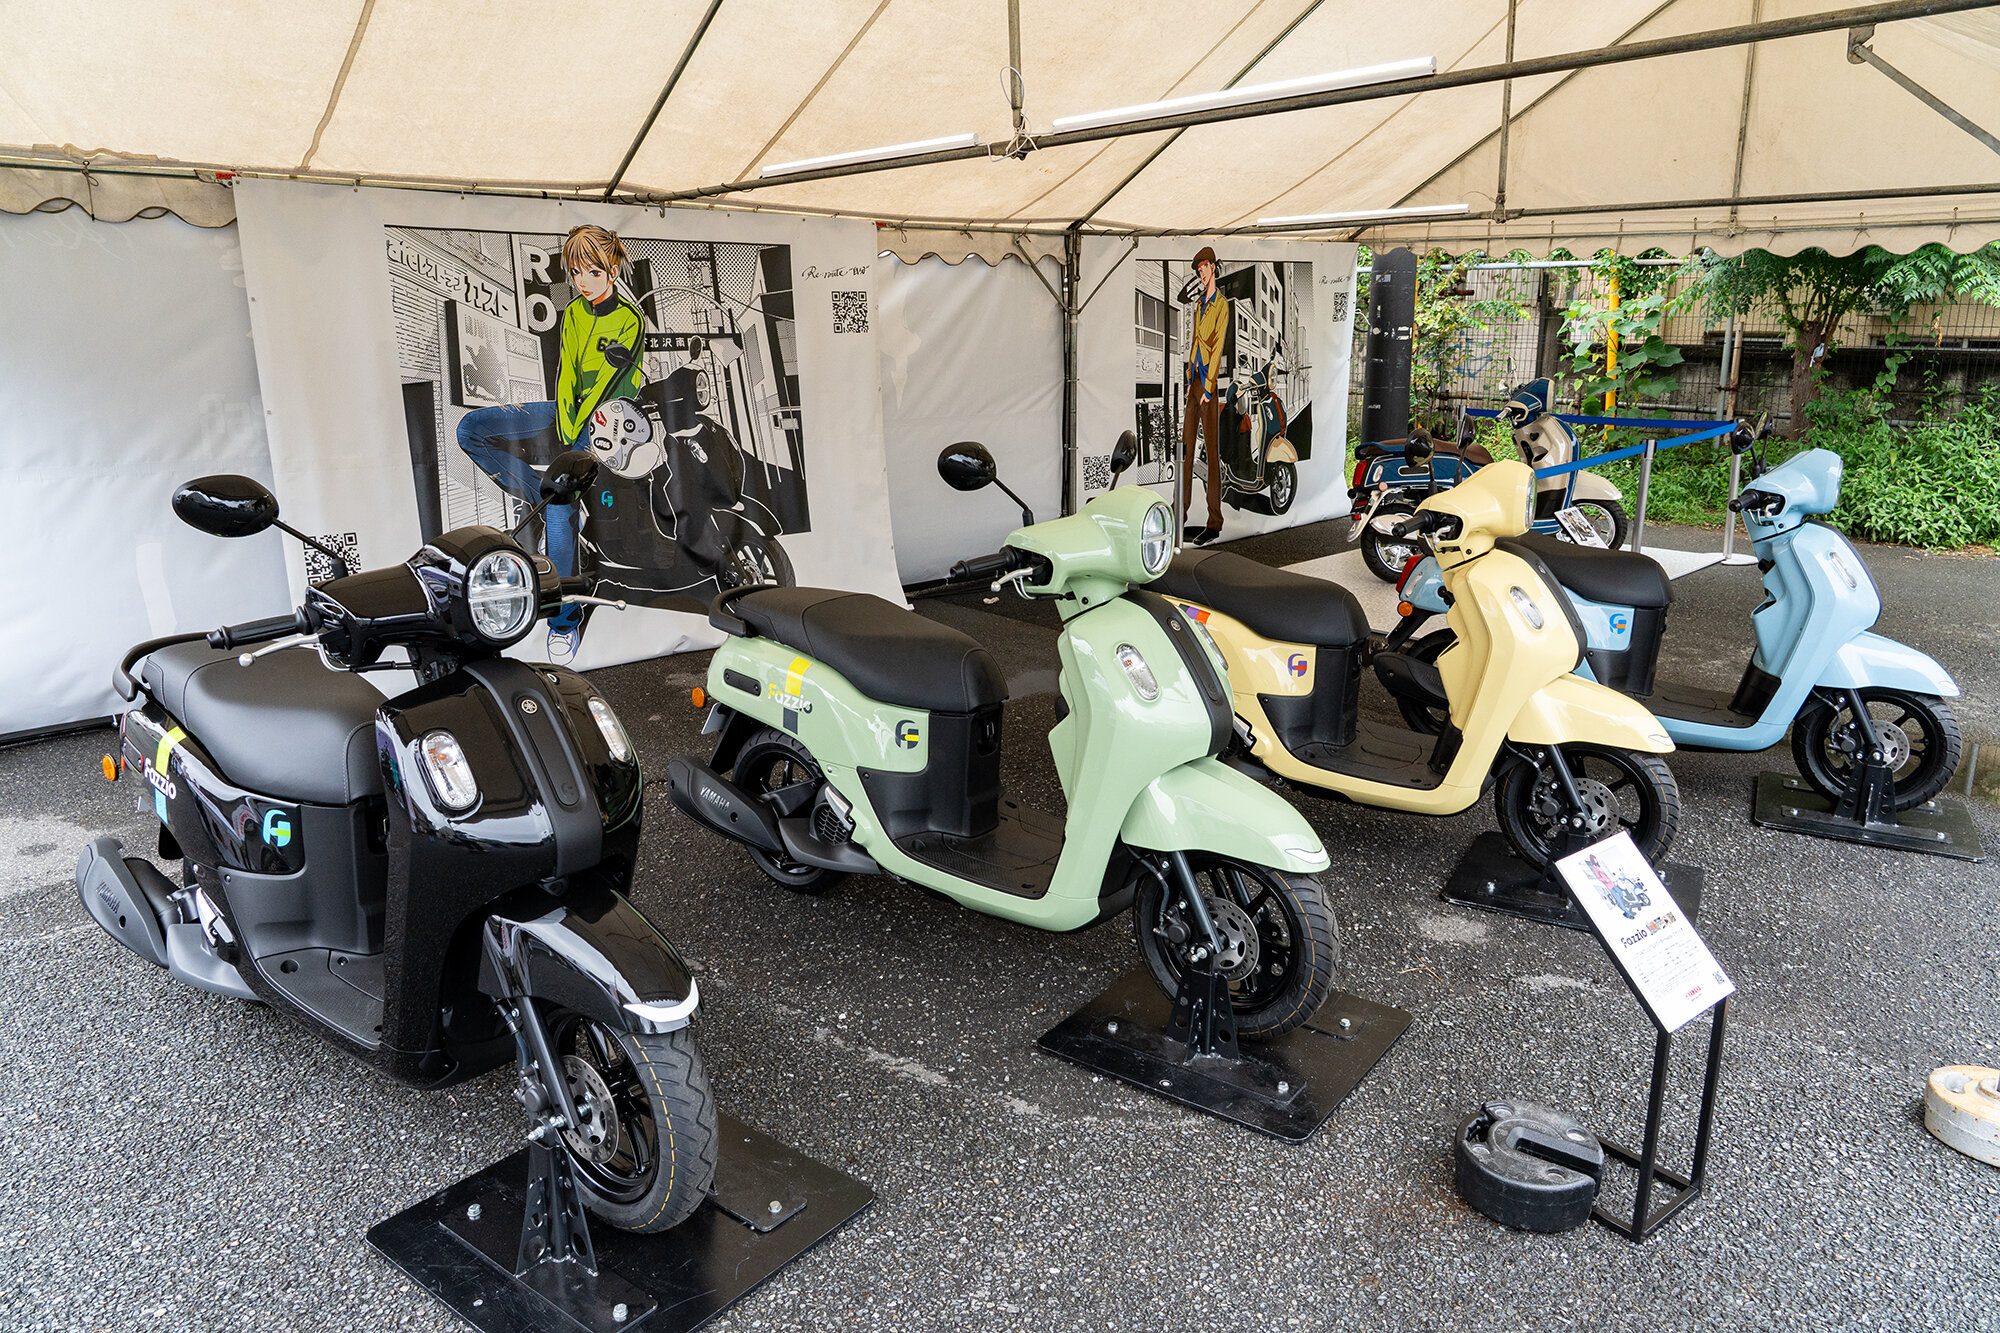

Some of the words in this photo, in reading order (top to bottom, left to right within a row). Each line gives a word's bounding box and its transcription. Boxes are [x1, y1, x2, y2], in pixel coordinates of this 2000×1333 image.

[767, 683, 813, 715] Fazzio
[144, 757, 177, 800] Fazzio
[699, 785, 730, 813] YAMAHA
[97, 881, 121, 915] YAMAHA
[1620, 929, 1648, 948] Fazzio
